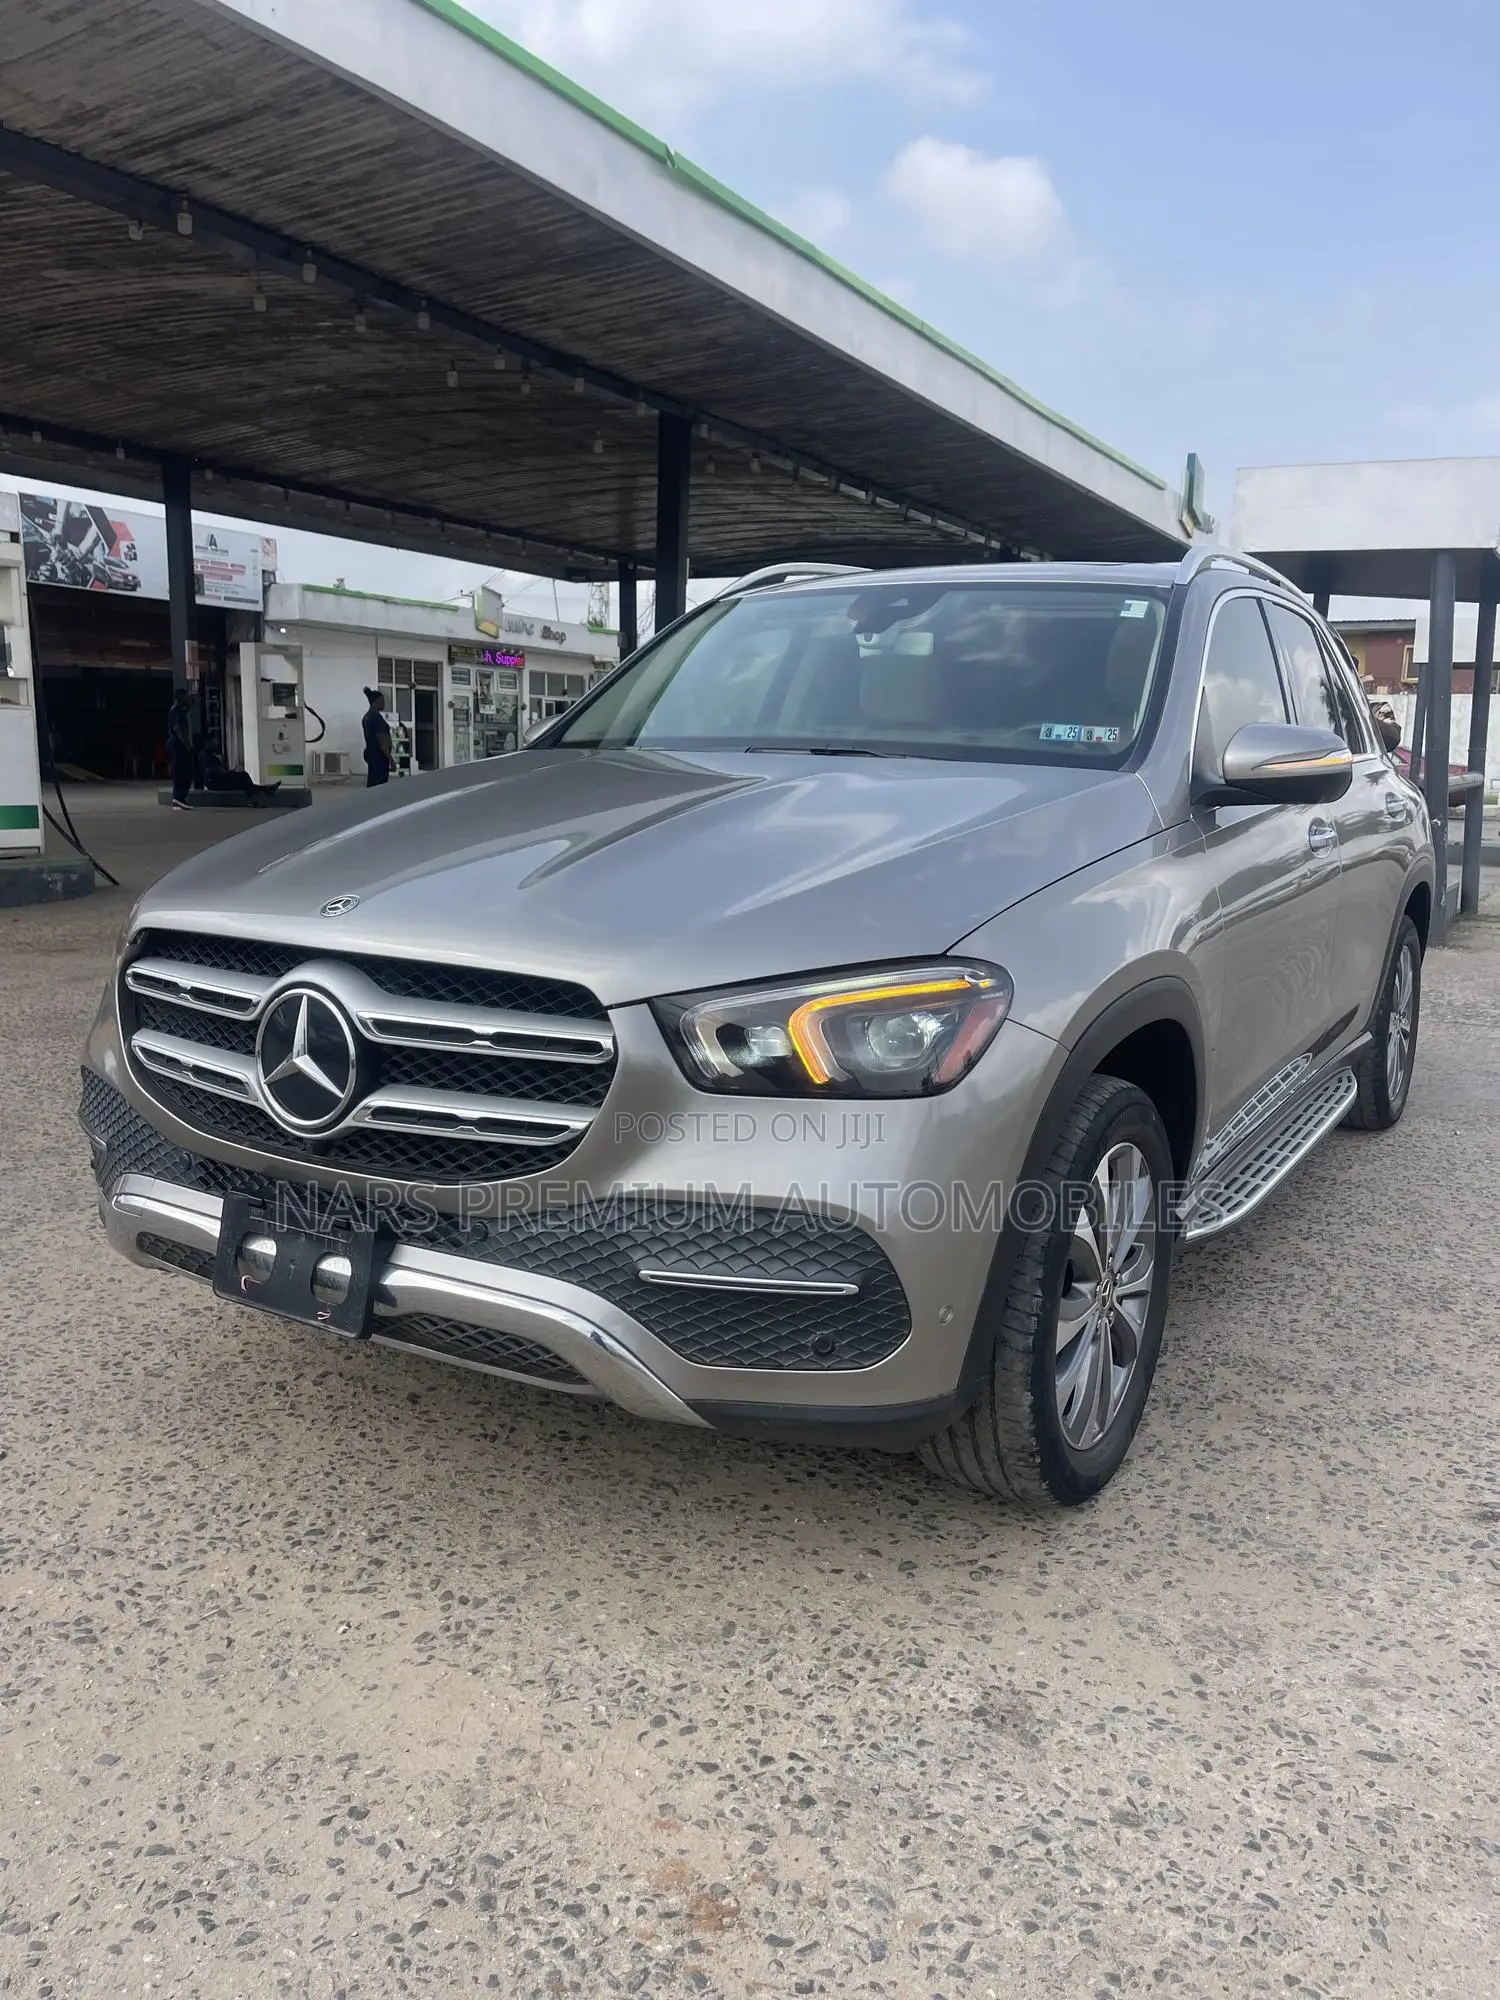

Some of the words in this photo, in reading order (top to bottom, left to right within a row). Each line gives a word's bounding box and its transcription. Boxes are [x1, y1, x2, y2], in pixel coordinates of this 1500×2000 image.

[541, 624, 567, 645] Shop
[1067, 726, 1078, 738] 25
[1107, 728, 1118, 741] 25
